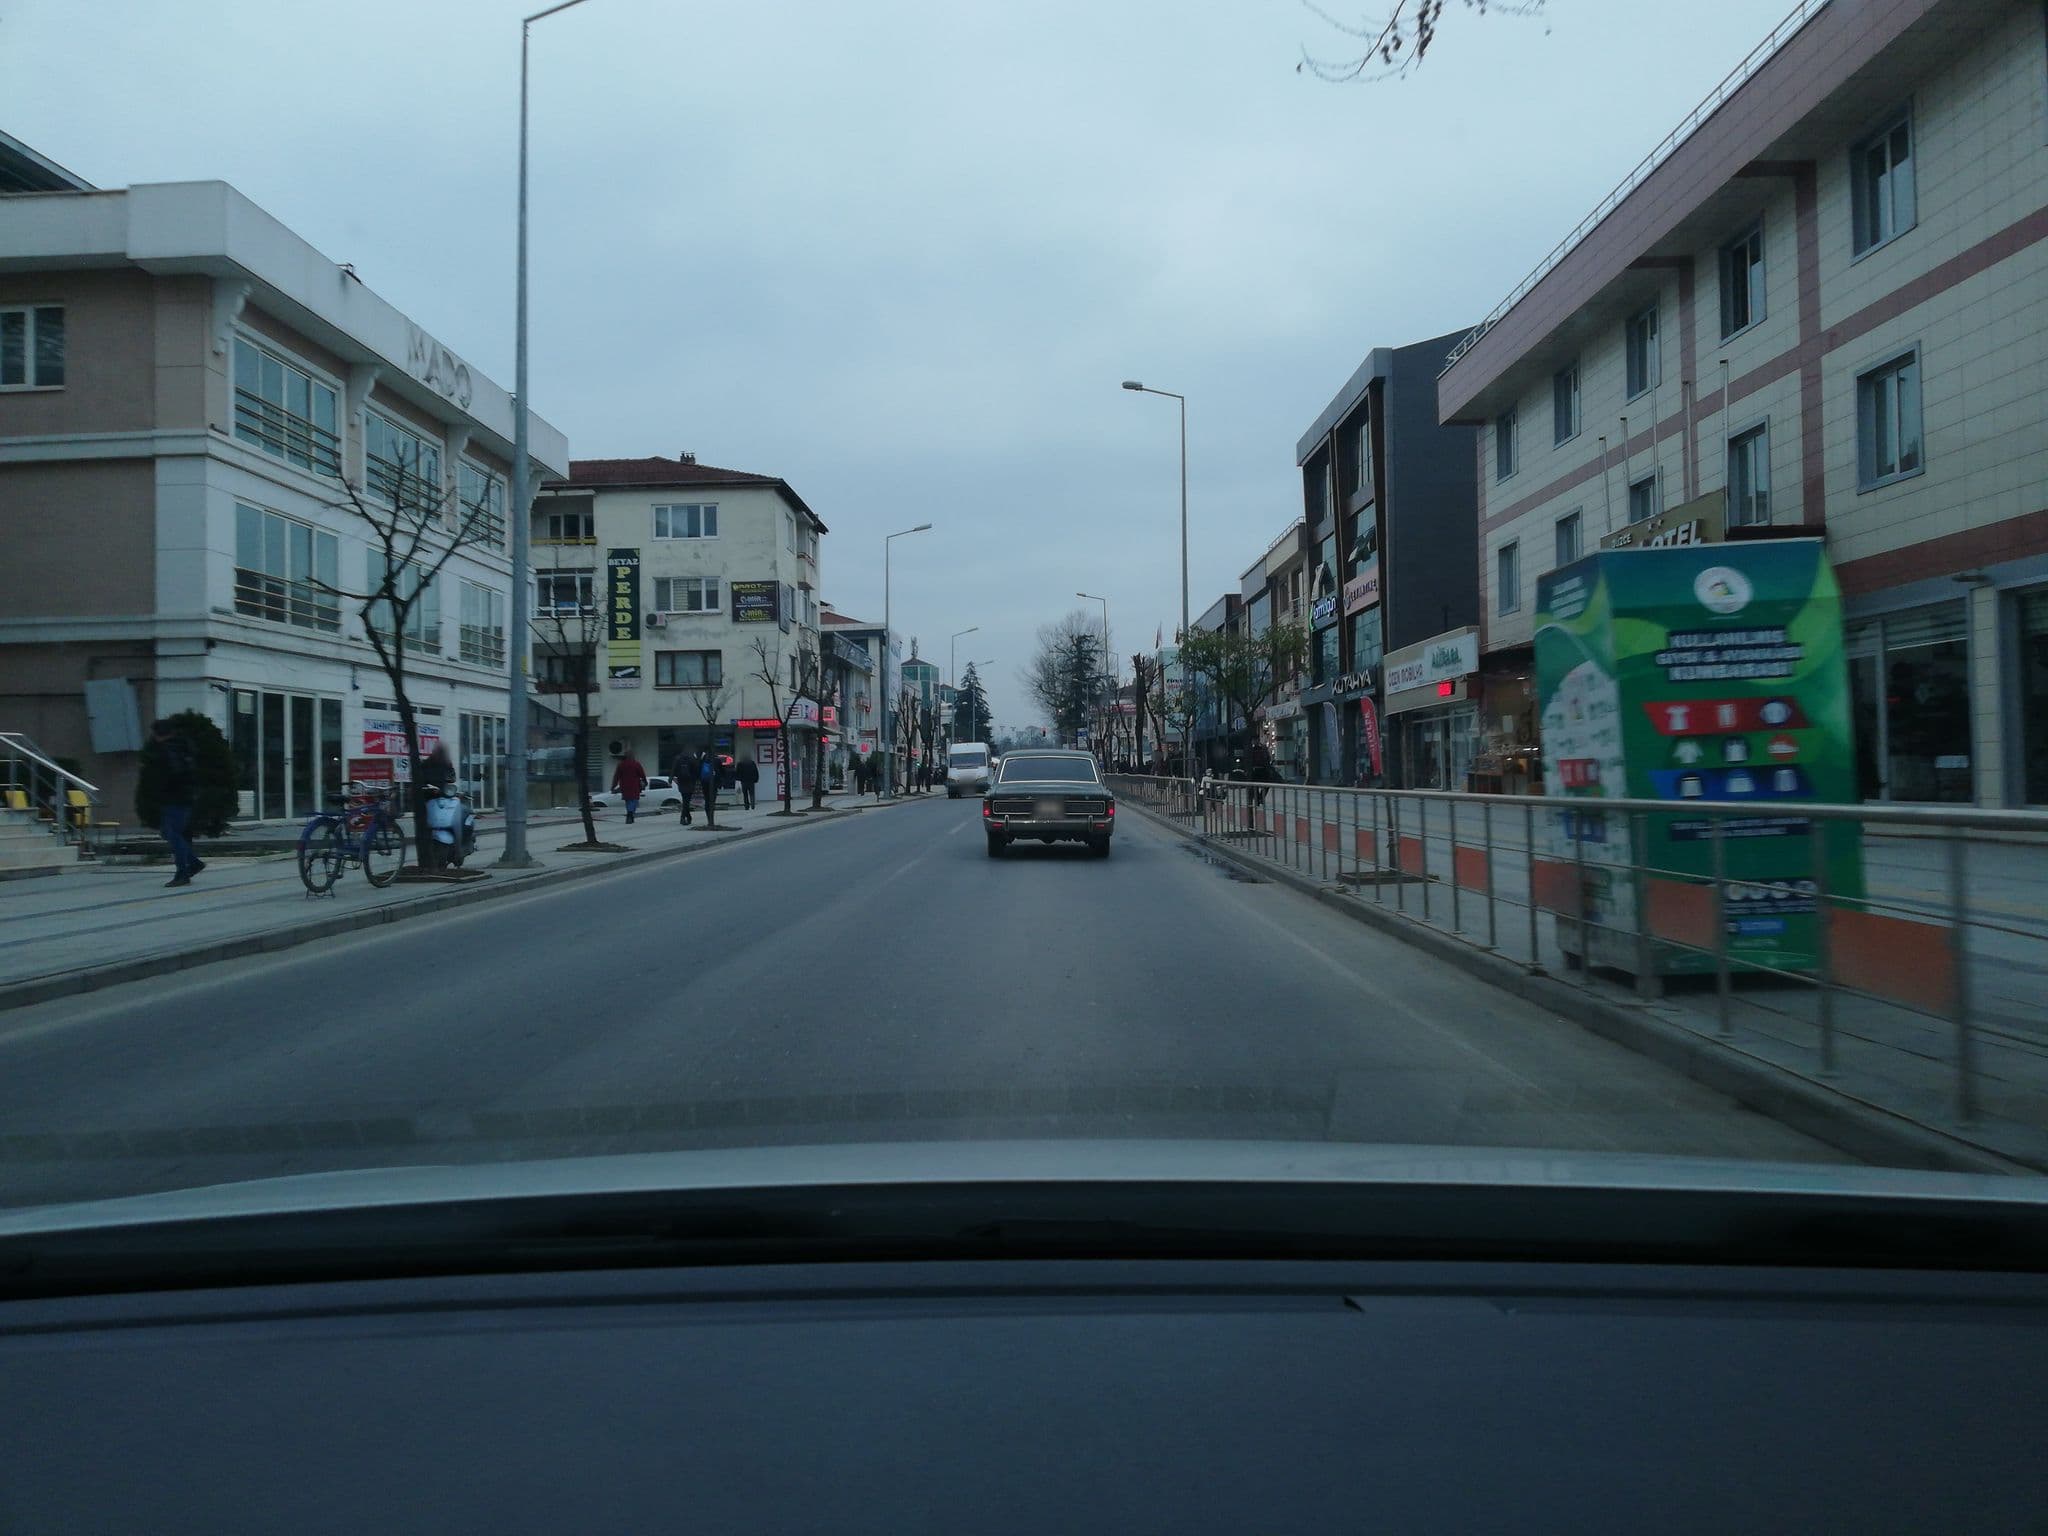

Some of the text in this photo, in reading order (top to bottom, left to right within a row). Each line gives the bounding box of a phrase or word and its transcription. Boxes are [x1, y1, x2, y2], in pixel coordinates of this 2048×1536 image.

[1640, 519, 1701, 549] OTEL
[608, 558, 640, 566] BEYAZ
[615, 566, 632, 639] PERDE
